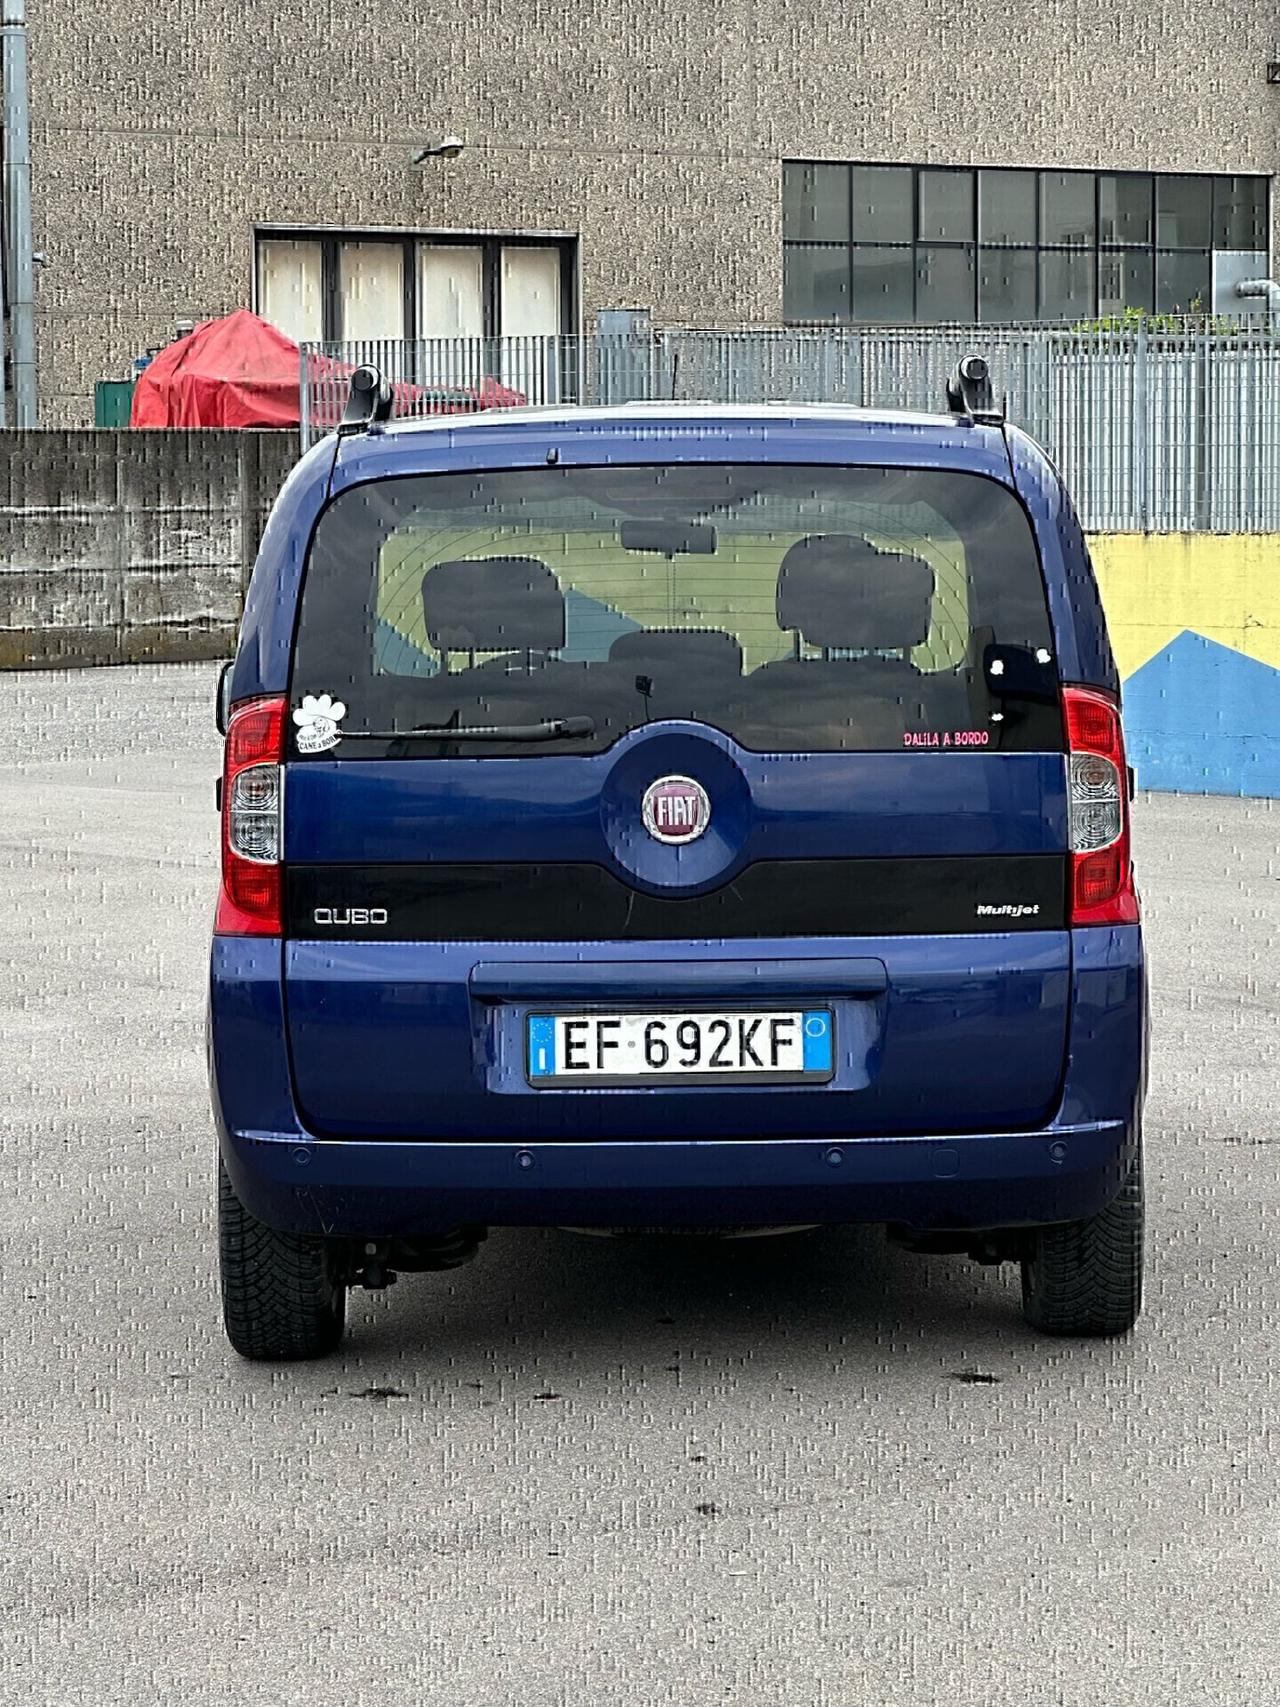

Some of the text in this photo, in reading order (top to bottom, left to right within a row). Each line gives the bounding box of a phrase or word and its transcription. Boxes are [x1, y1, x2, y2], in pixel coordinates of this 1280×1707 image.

[299, 741, 317, 751] CANE
[943, 732, 951, 746] A
[954, 731, 989, 745] BORDO
[657, 796, 696, 826] FIAT
[314, 908, 388, 924] QUBO
[976, 904, 1040, 917] Multijet
[563, 1017, 796, 1070] EF 692KF
